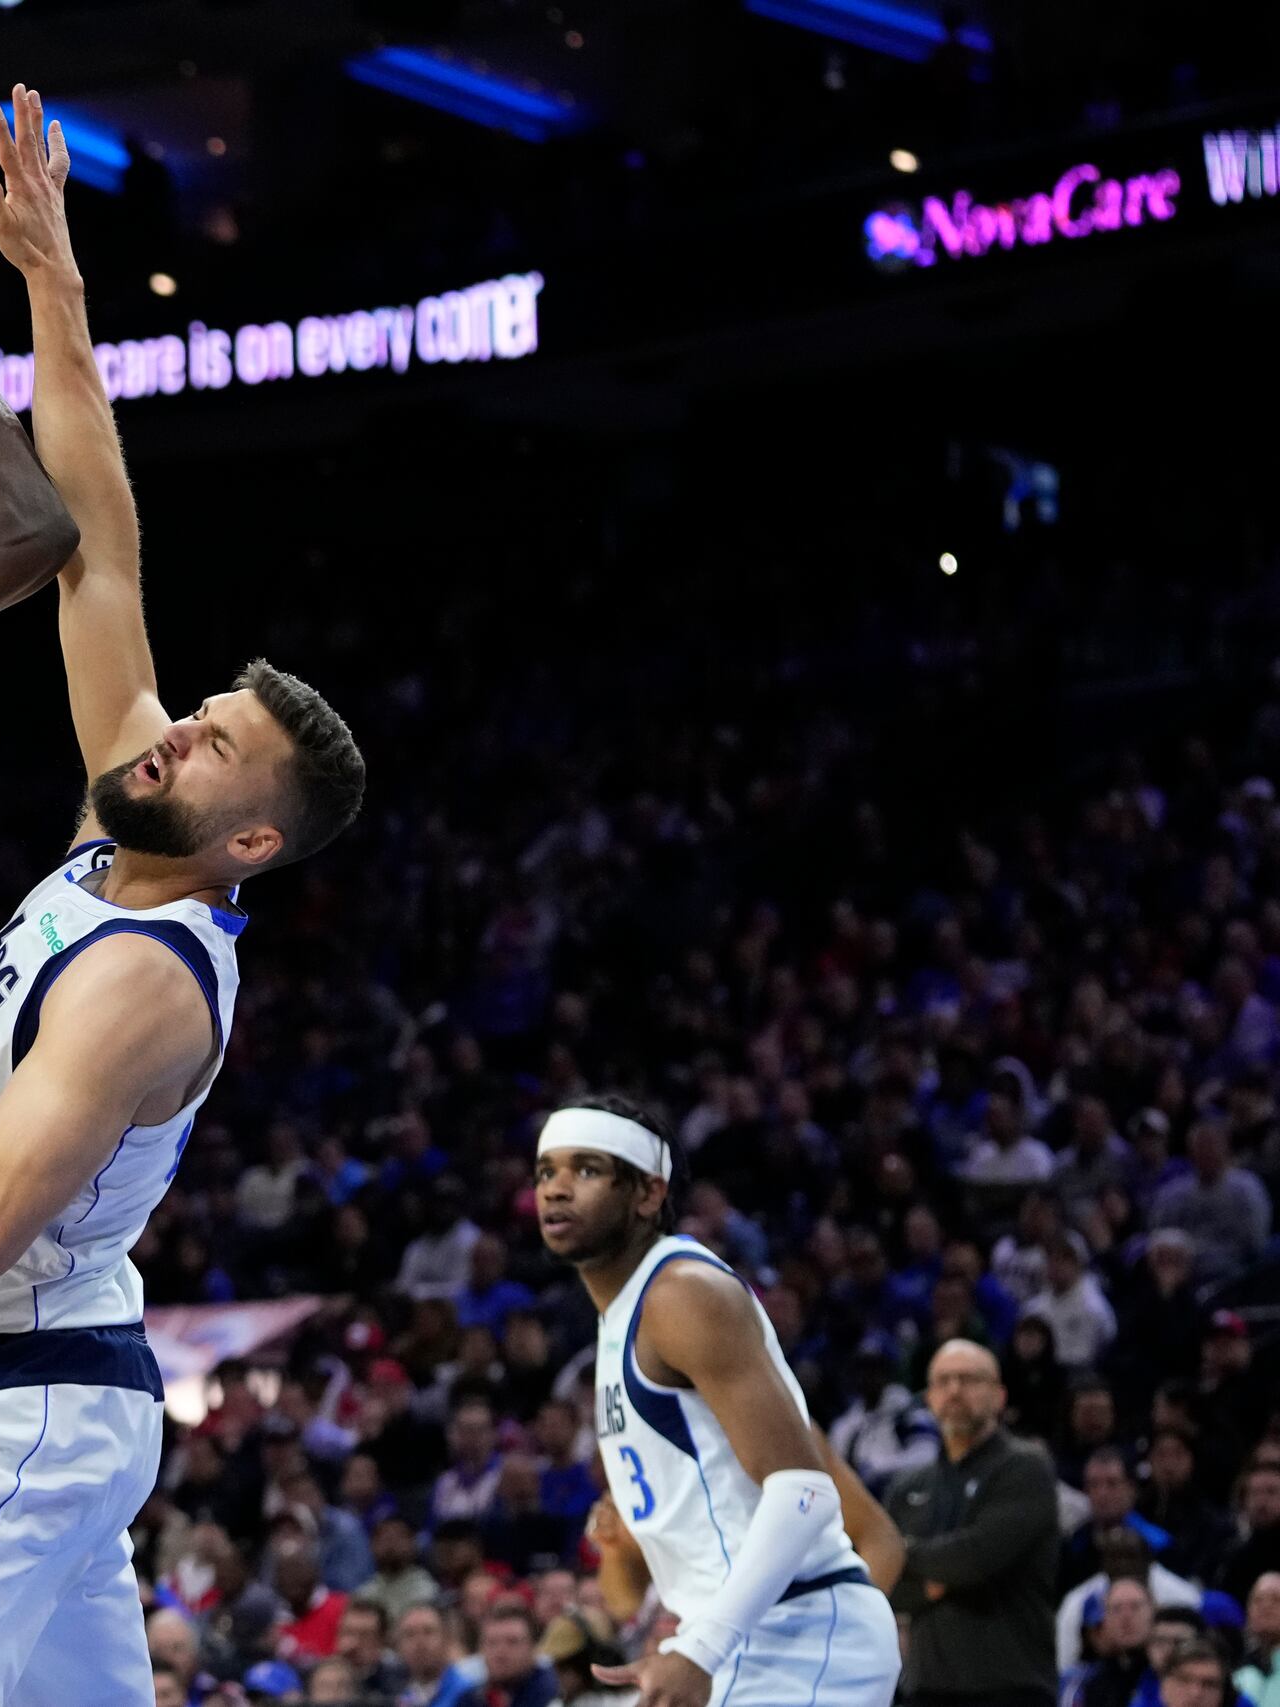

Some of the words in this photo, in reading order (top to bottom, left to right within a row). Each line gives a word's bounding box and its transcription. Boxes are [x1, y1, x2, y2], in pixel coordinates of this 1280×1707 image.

[916, 164, 1181, 267] NovaCare
[188, 320, 232, 391] is
[234, 321, 295, 386] on
[296, 305, 416, 375] every
[416, 271, 545, 365] corner
[619, 1445, 656, 1522] 3
